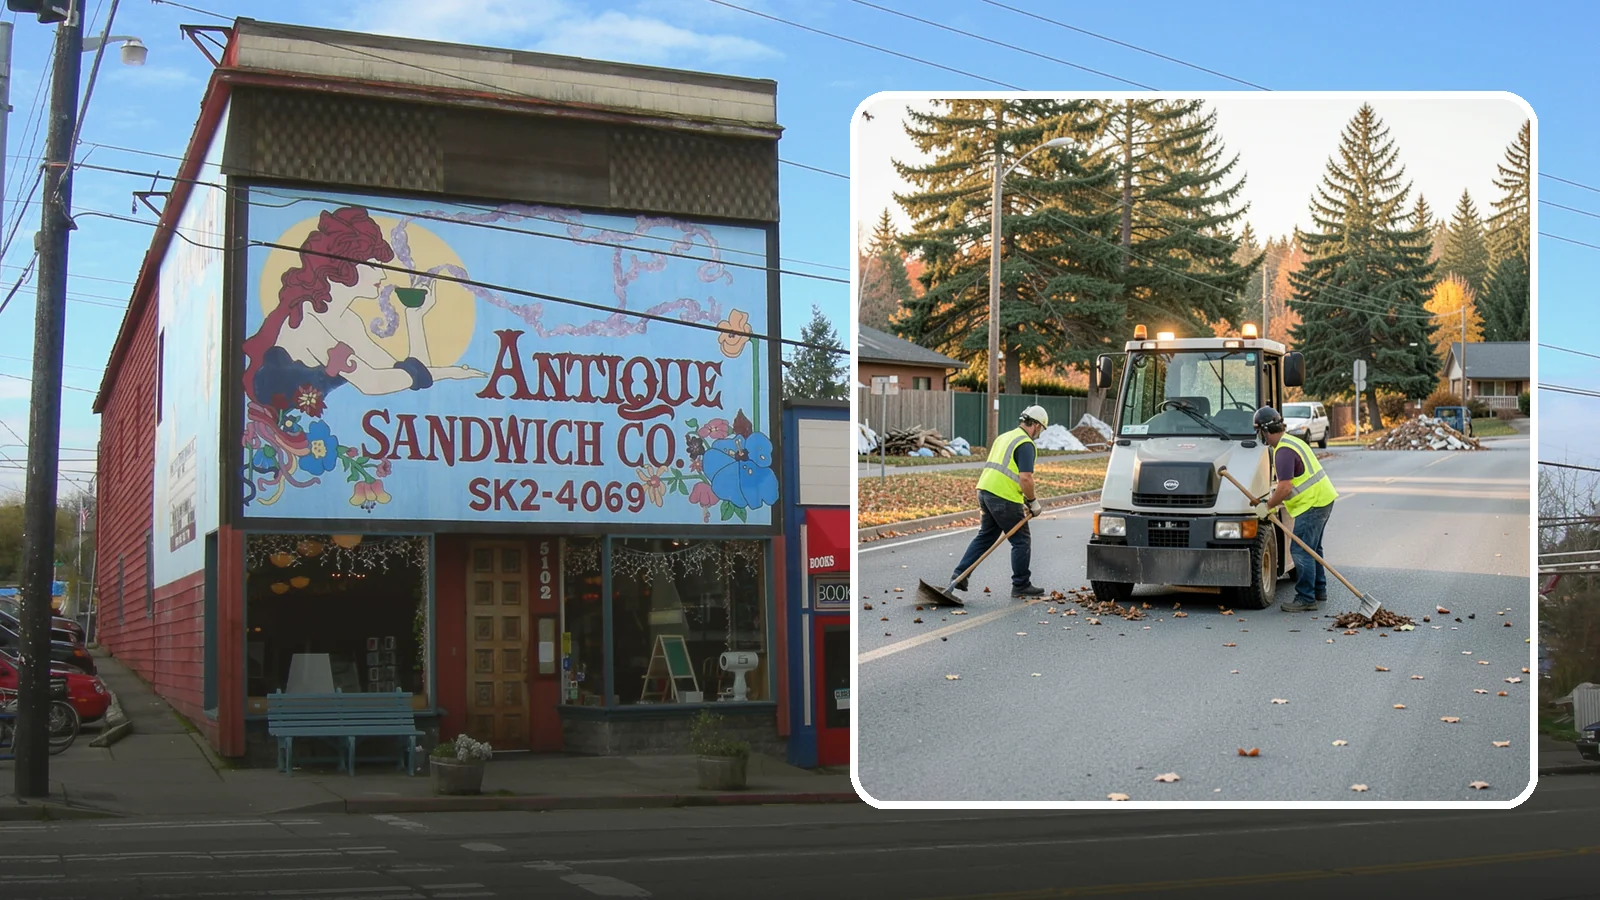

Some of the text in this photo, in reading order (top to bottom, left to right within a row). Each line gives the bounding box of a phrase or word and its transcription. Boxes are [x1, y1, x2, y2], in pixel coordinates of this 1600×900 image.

[476, 328, 723, 420] ANTIQUE
[361, 408, 685, 468] SANDWICH CO.
[468, 478, 646, 511] SK2-4069
[539, 541, 552, 600] 5102
[809, 555, 835, 569] BOOKS
